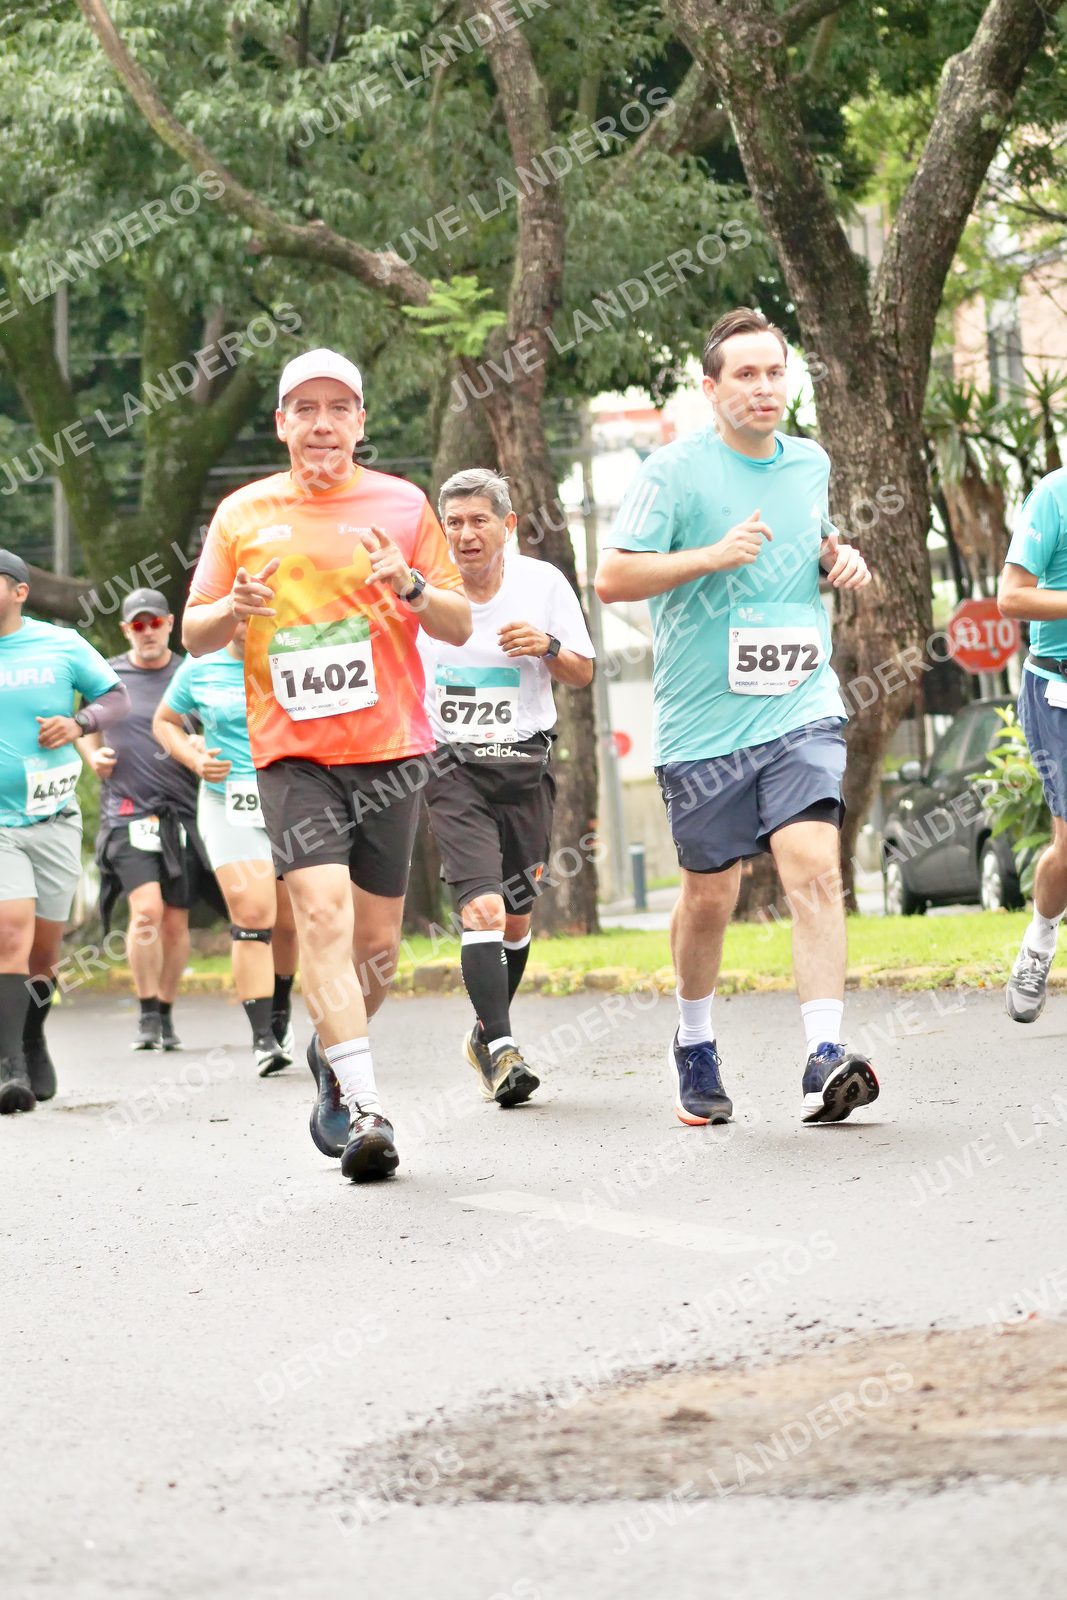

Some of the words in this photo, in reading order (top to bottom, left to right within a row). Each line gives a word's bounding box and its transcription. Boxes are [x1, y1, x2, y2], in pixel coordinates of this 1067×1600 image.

[956, 618, 1014, 649] ALTO
[736, 643, 819, 672] 5872
[280, 660, 369, 698] 1402
[440, 700, 513, 725] 6726
